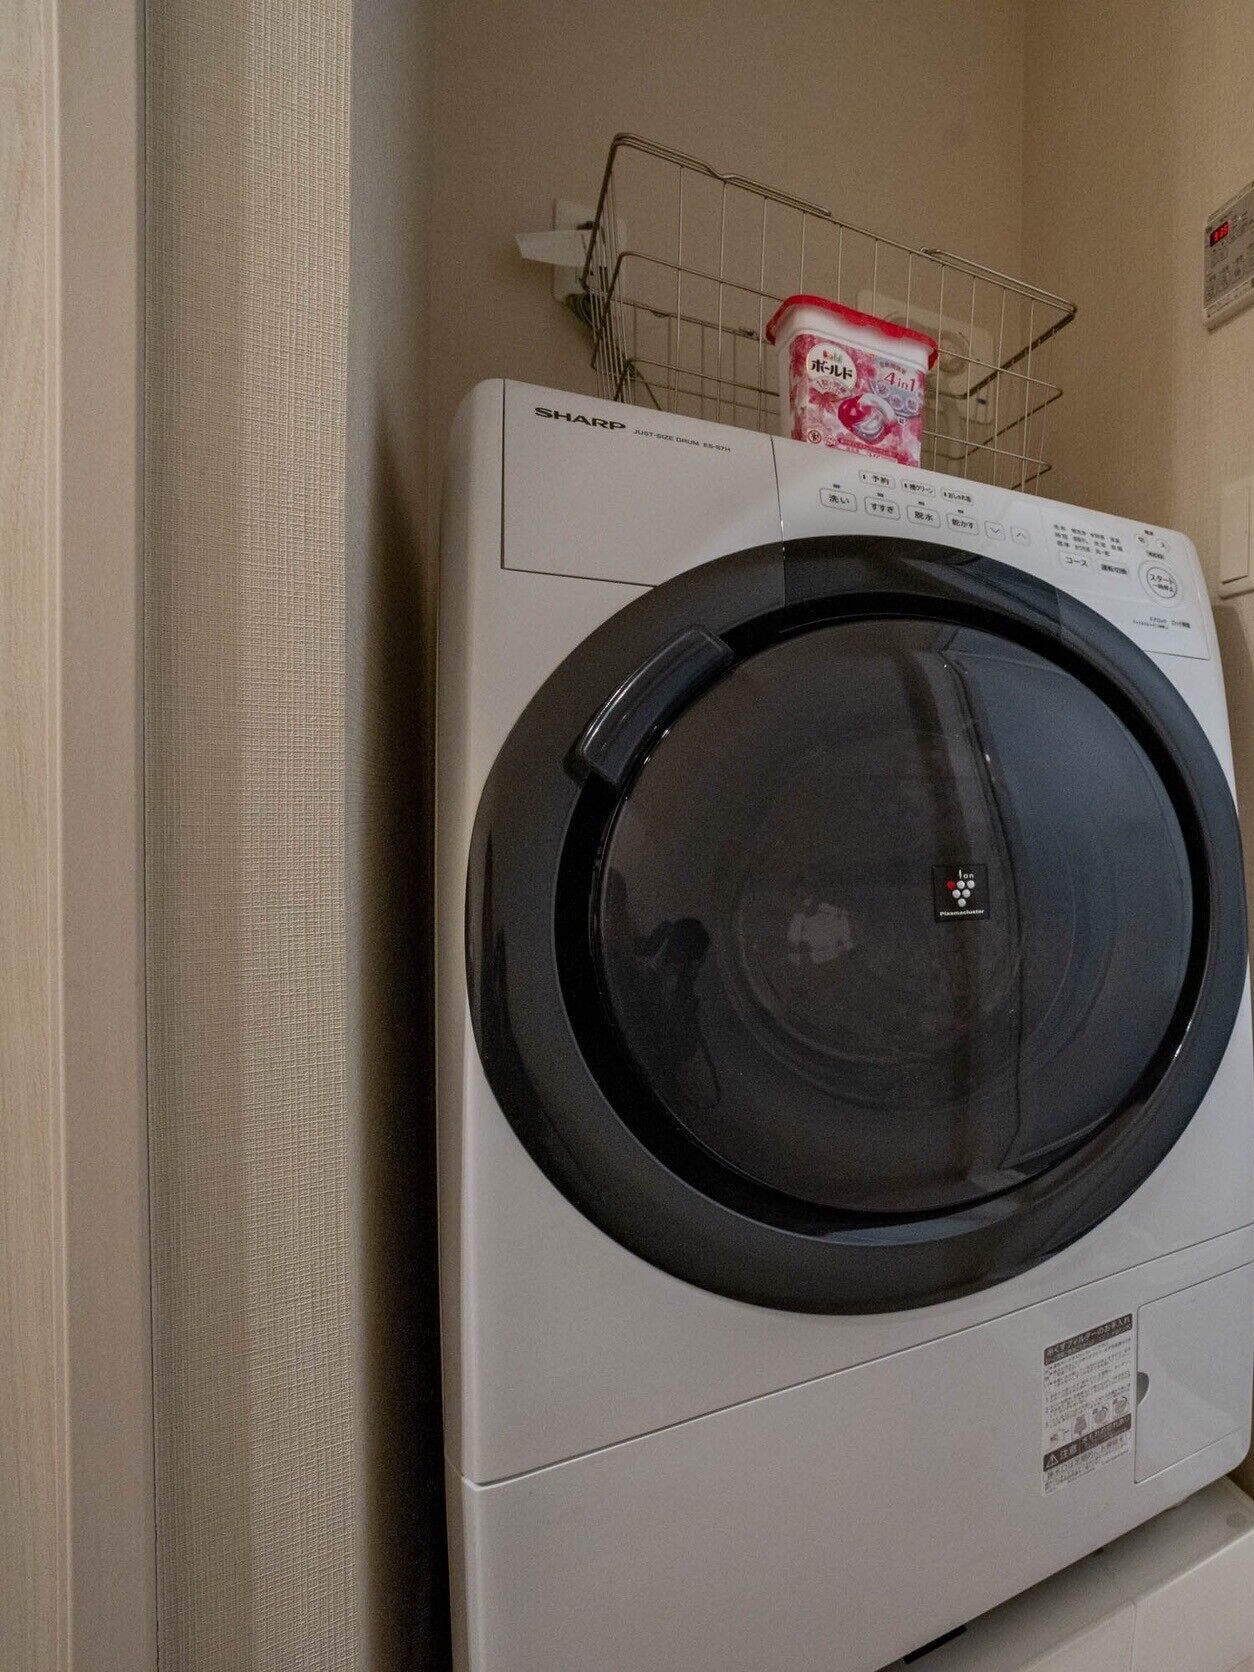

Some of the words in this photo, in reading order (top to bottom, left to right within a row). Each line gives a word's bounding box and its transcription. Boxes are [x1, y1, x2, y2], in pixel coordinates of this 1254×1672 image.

[811, 360, 853, 379] ボールド
[533, 407, 627, 430] SHARP
[633, 429, 674, 442] JUST-SIZE
[676, 437, 700, 446] DRUM
[871, 475, 890, 486] 予約
[828, 493, 850, 505] 洗い
[870, 503, 894, 514] すすぎ
[914, 511, 934, 521] 脱水
[951, 518, 974, 530] 乾かす
[1065, 556, 1088, 567] コース
[1149, 573, 1175, 586] スタート
